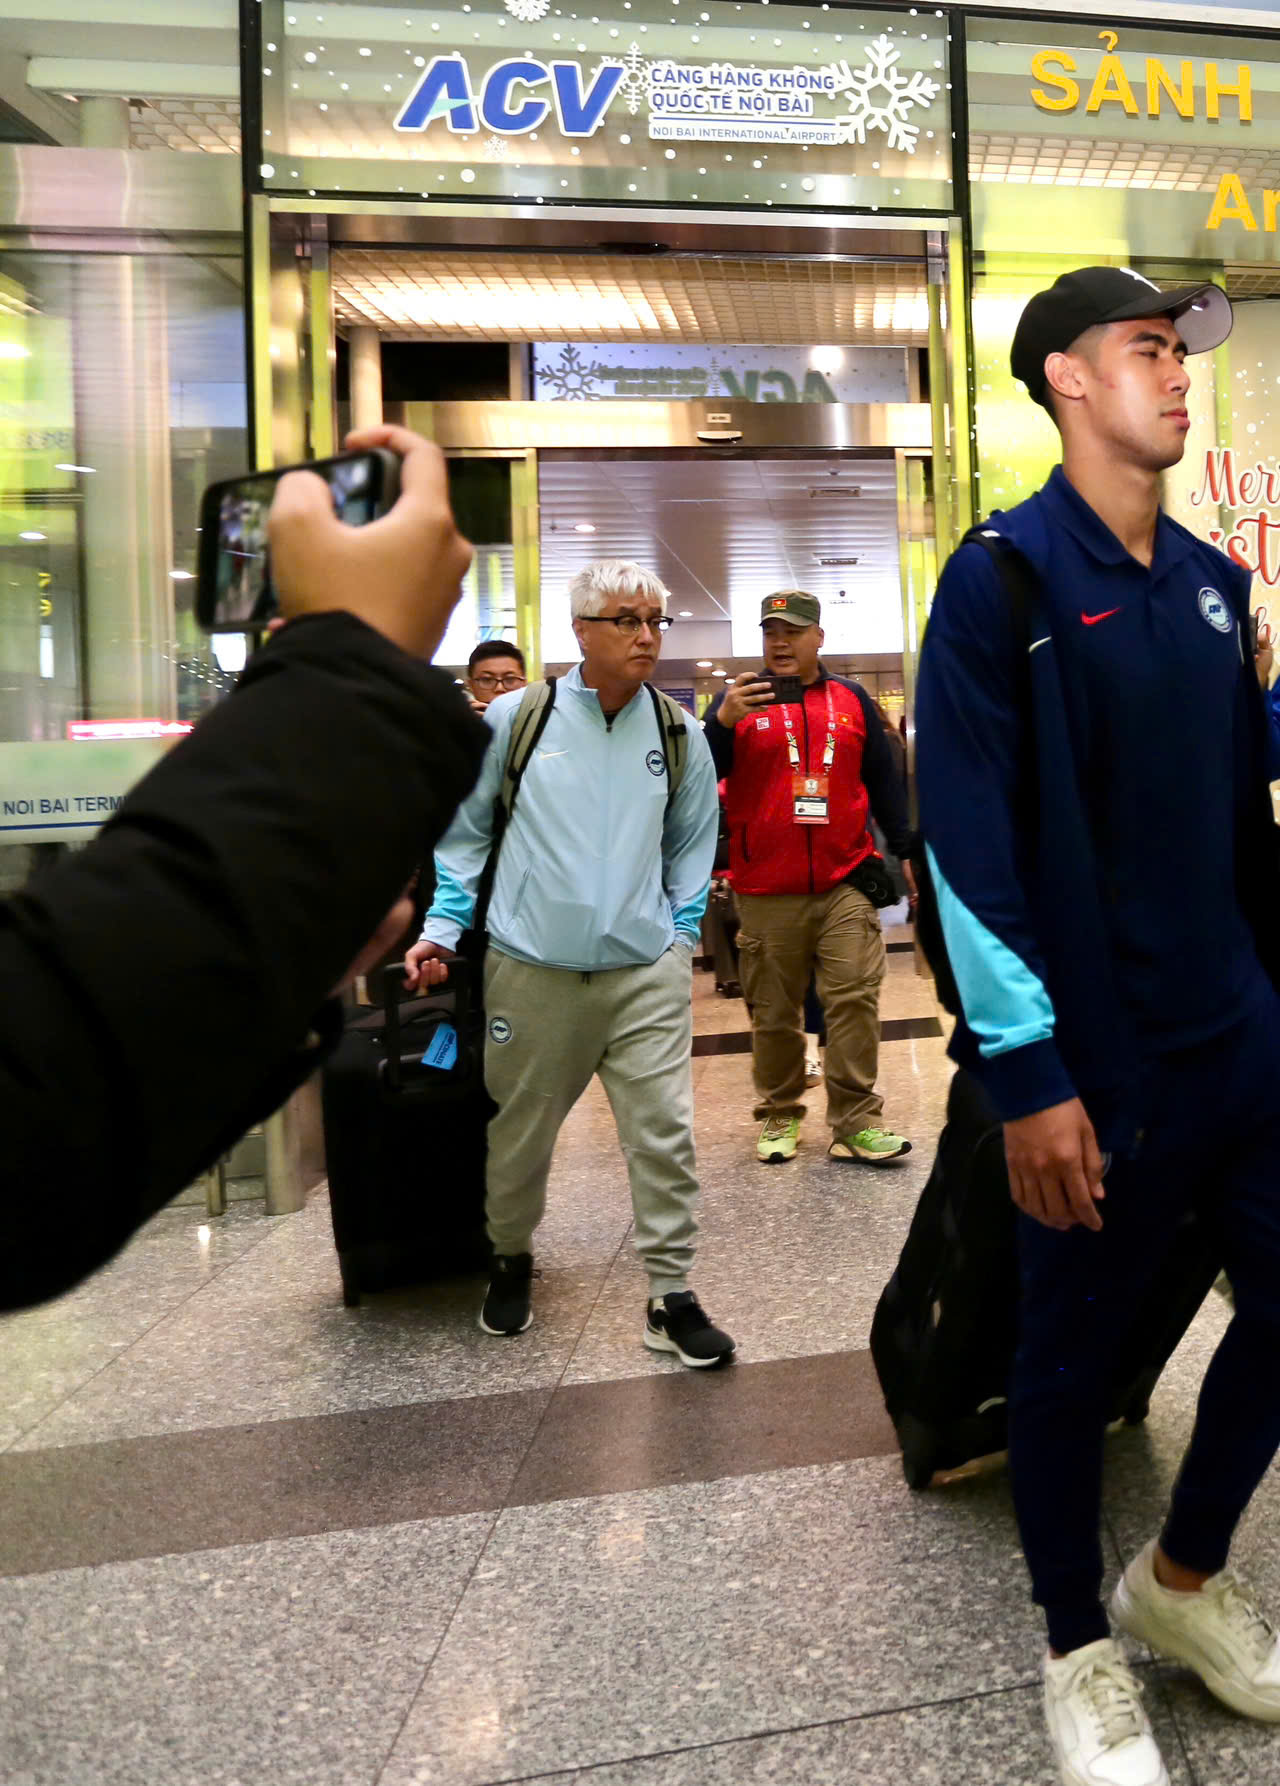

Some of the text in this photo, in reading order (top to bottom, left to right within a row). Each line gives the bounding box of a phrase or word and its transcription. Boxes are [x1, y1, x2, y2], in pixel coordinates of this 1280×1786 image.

[710, 68, 763, 87] HÀNG
[769, 71, 835, 90] KHÔNG
[1030, 30, 1253, 122] SẢNH
[396, 58, 627, 135] ACV
[652, 88, 809, 115] QUỐC TẾ NỘI BÀI
[653, 127, 836, 142] NOI BAI INTERNATIONAL AIRPORT
[3, 799, 34, 815] NOI
[40, 797, 70, 814] BAI
